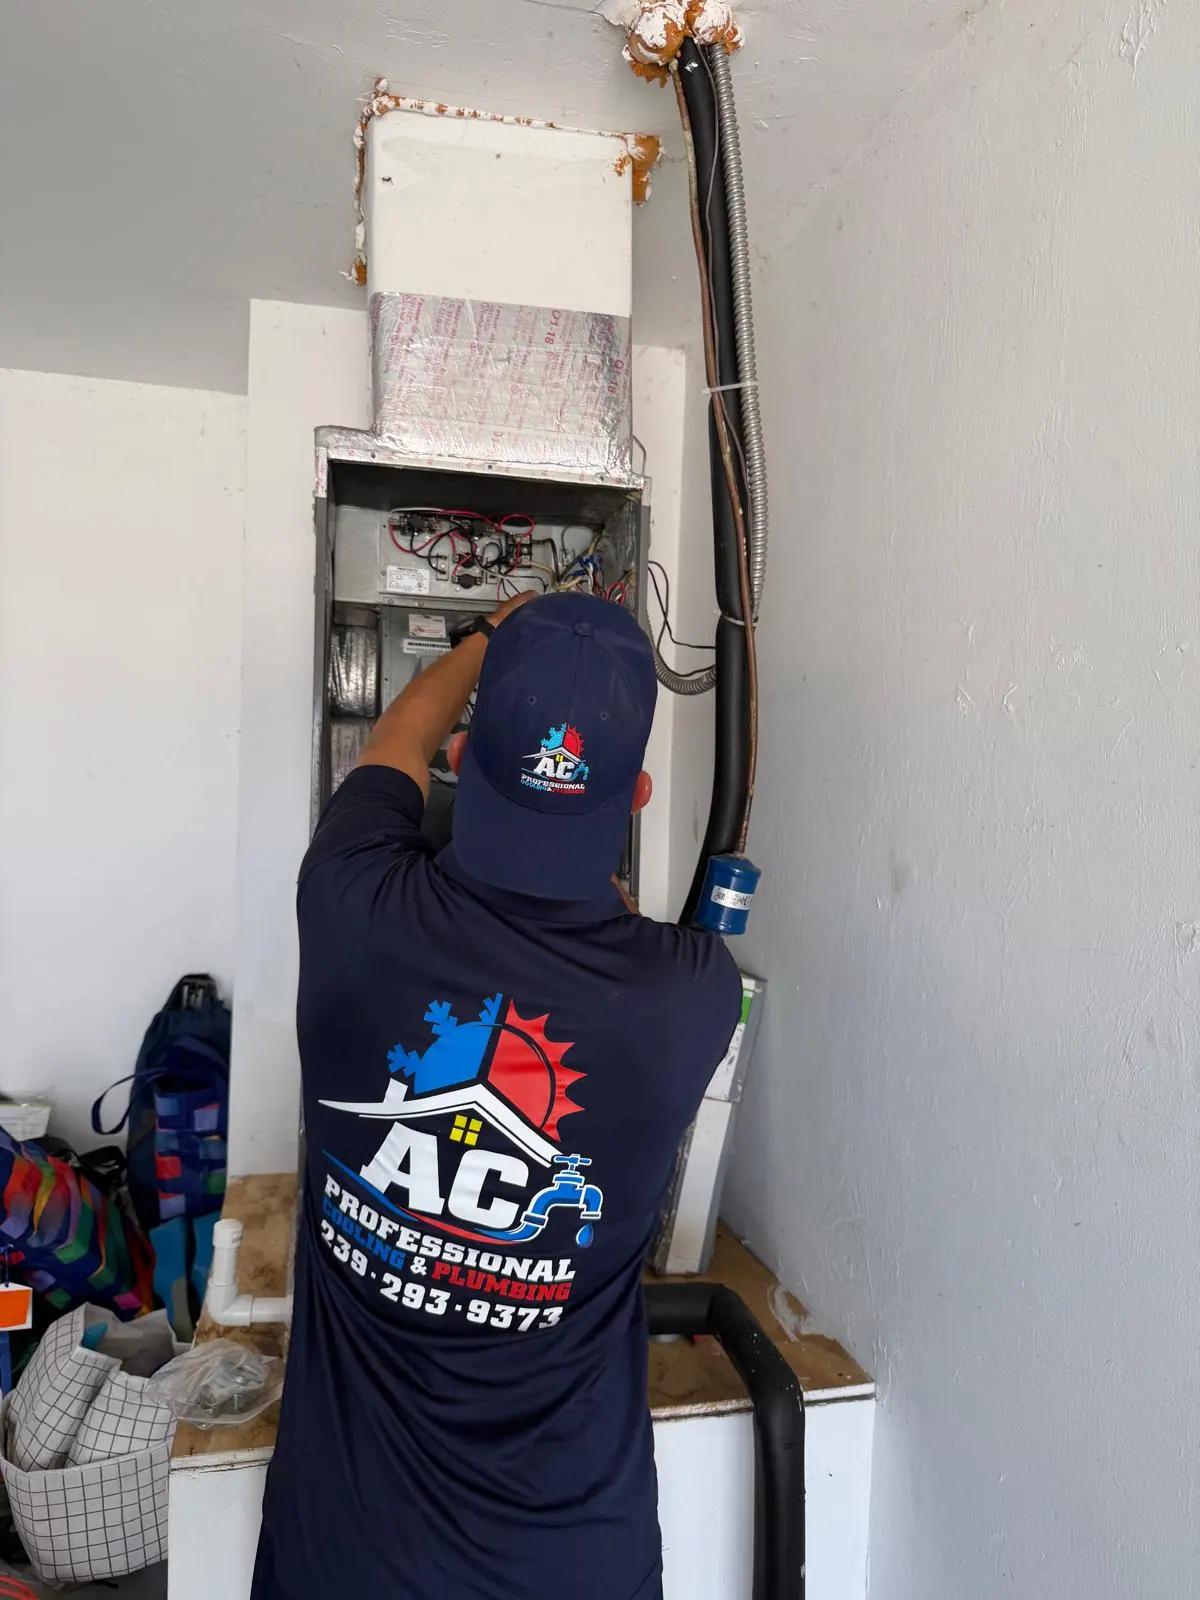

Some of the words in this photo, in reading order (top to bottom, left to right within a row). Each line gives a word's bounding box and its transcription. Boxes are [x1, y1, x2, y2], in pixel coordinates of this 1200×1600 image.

[521, 773, 586, 790] PROFESSIONAL
[533, 756, 575, 780] AC
[324, 1173, 576, 1282] PROFESSIONAL
[360, 1122, 529, 1229] AC
[322, 1195, 407, 1270] COOLING
[410, 1255, 428, 1276] &
[431, 1260, 573, 1302] PLUMBING
